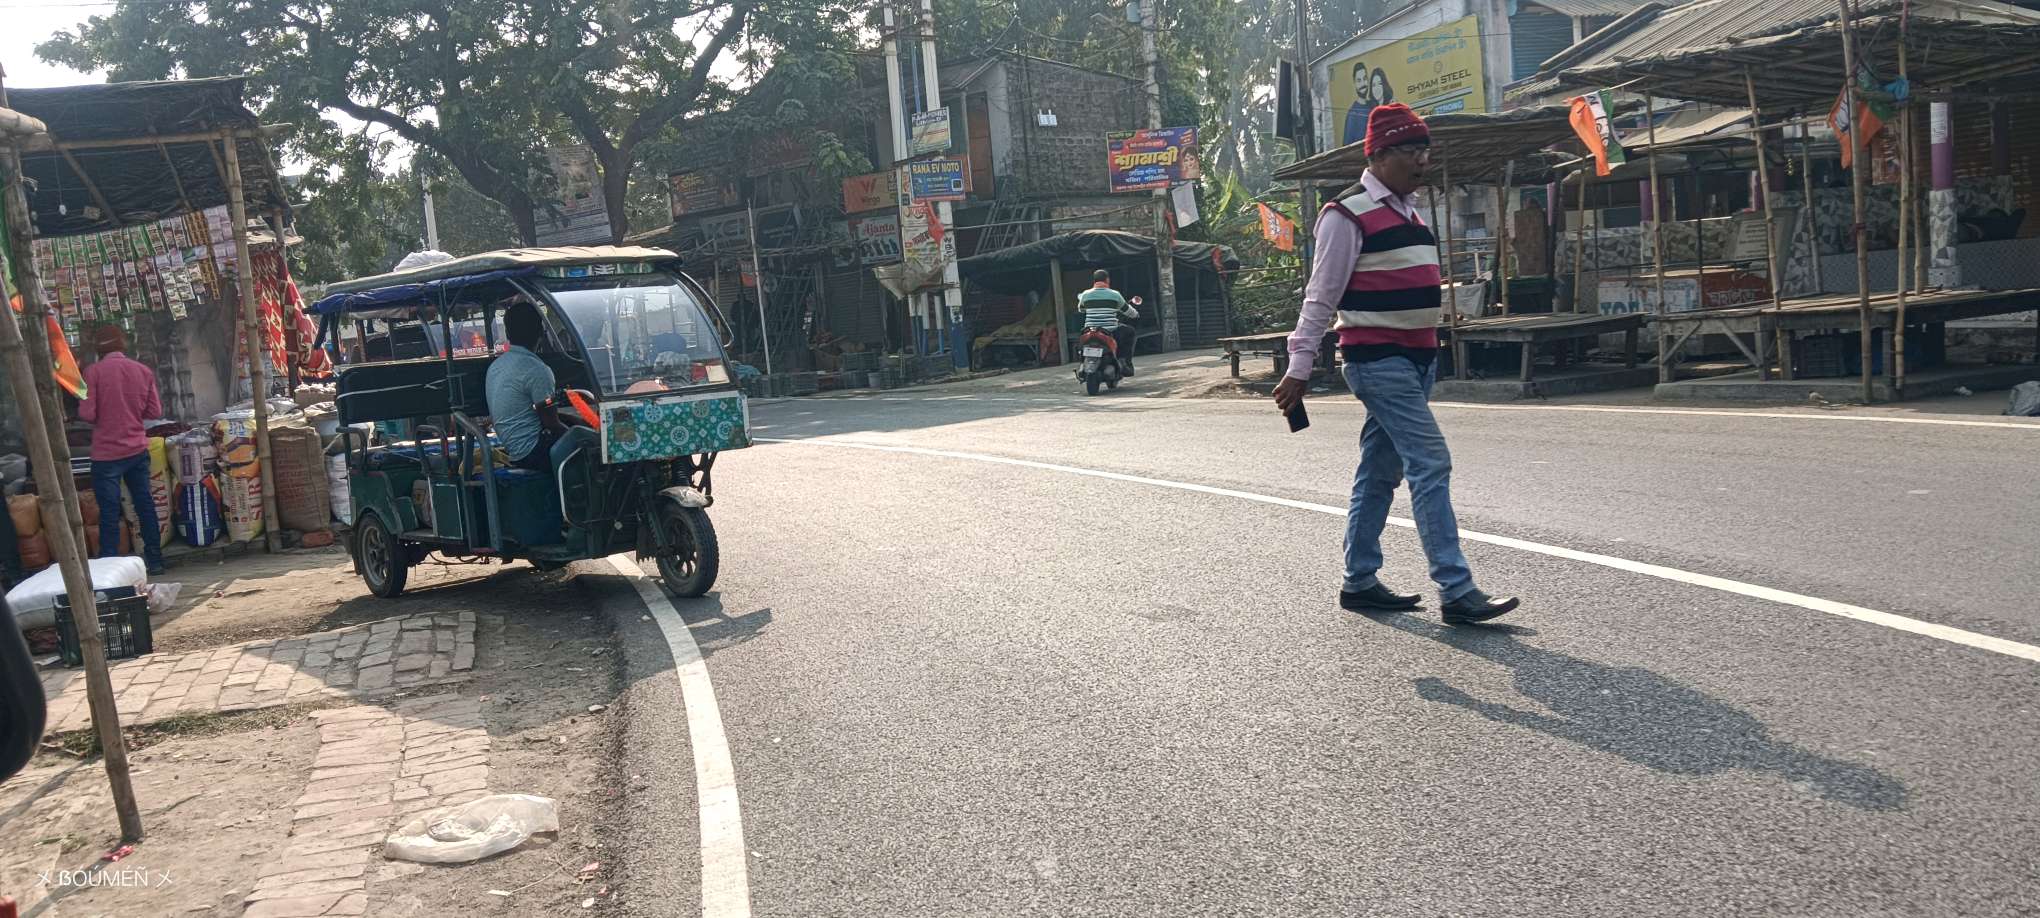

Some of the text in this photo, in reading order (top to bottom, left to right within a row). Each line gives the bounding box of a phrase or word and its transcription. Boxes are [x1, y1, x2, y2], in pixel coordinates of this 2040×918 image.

[1407, 78, 1439, 95] SHYAM
[1440, 69, 1472, 84] STEEL
[912, 163, 930, 174] RANA
[931, 163, 940, 173] EV
[1114, 146, 1178, 170] শ্যামাশ্রী
